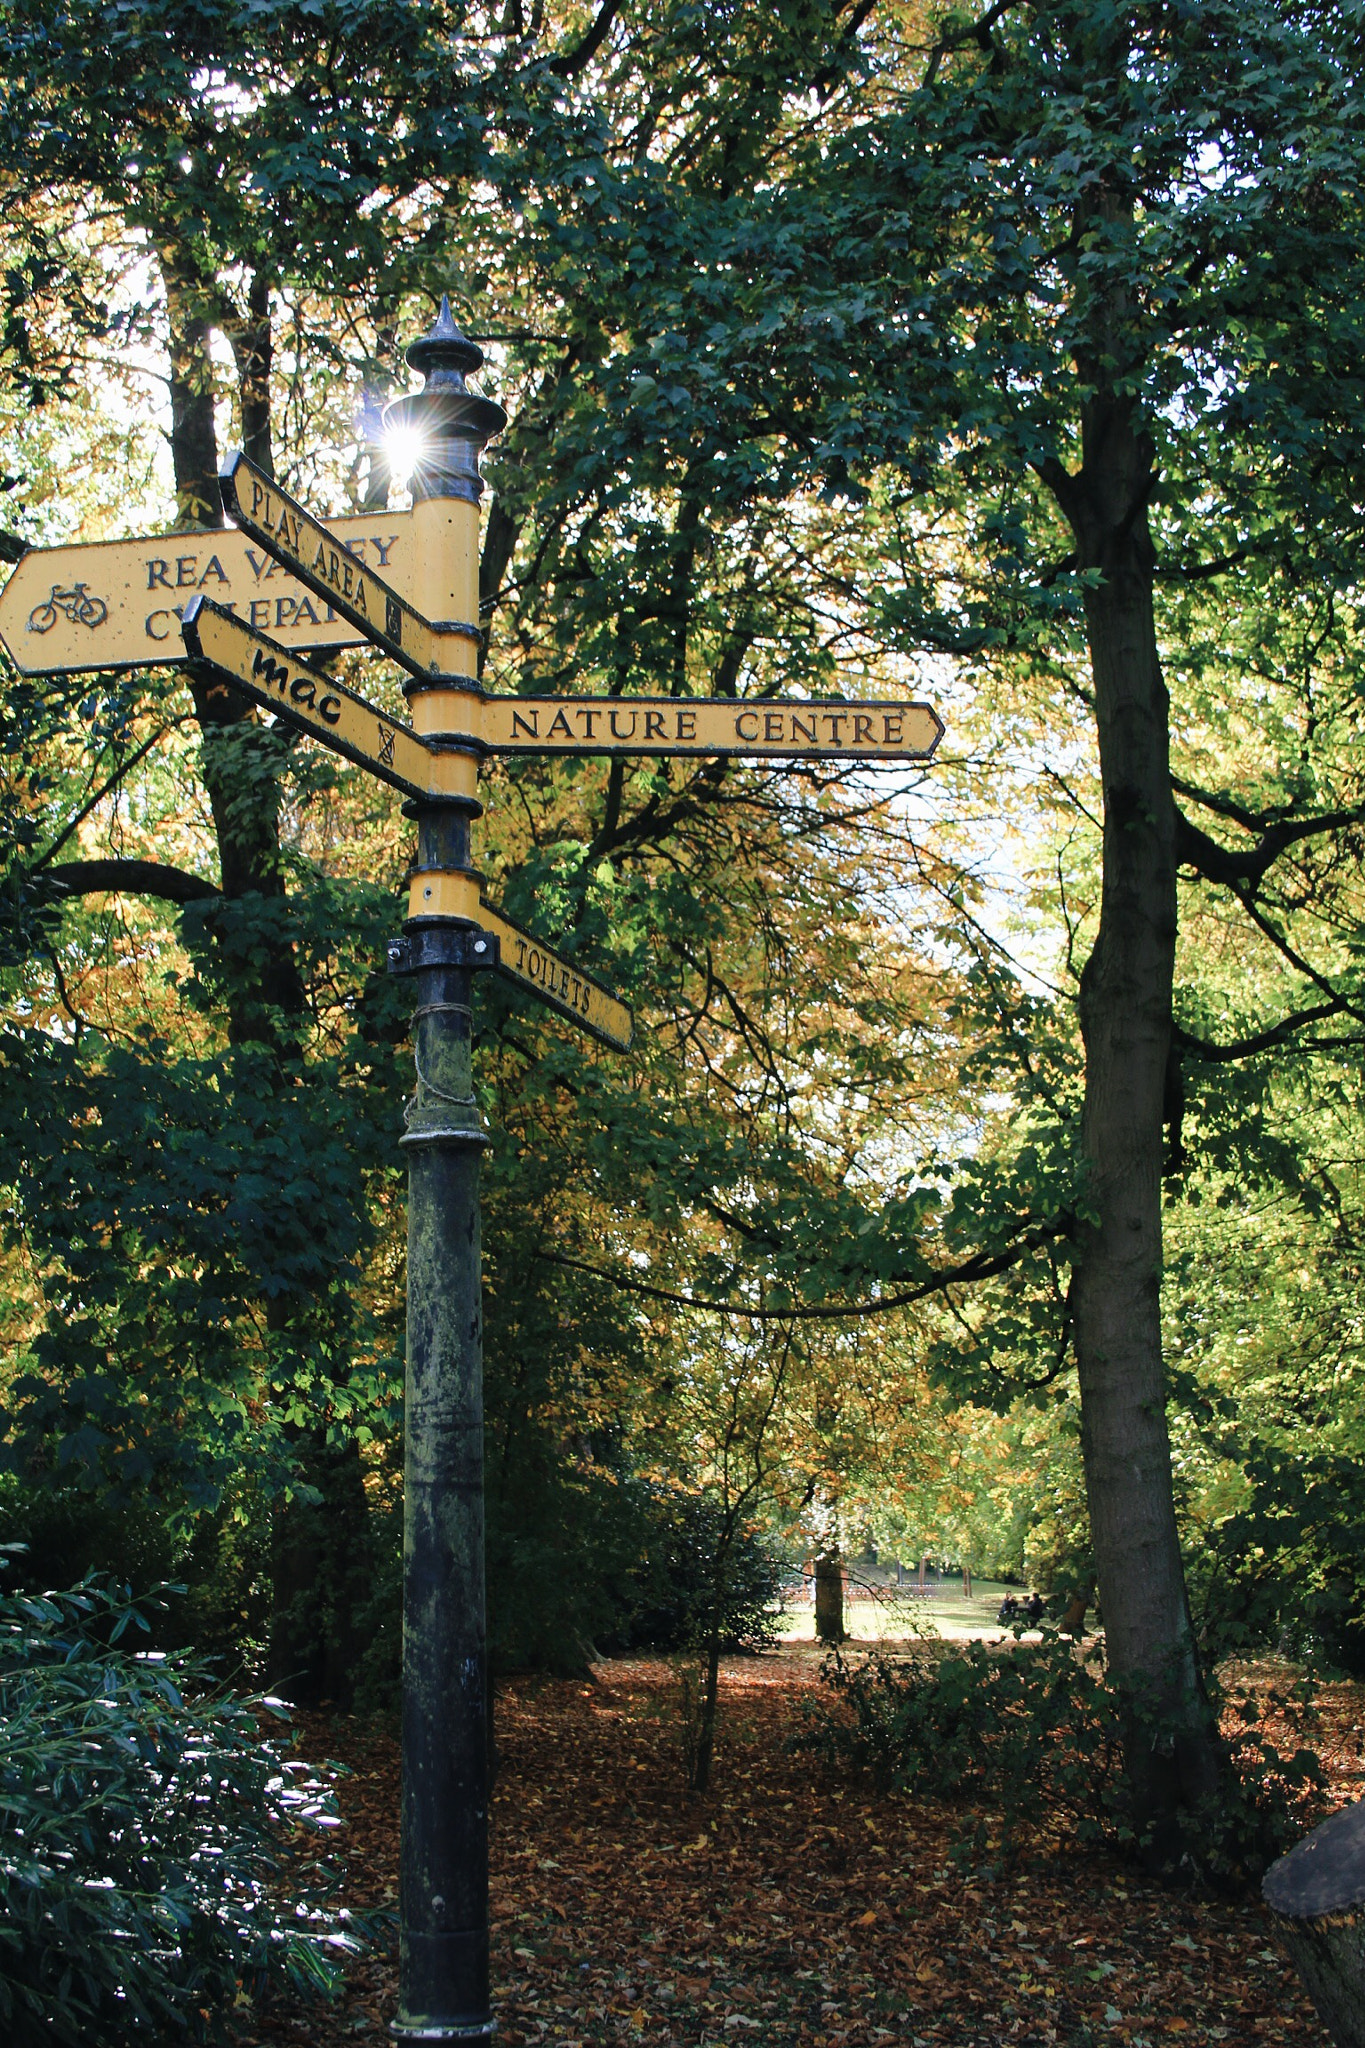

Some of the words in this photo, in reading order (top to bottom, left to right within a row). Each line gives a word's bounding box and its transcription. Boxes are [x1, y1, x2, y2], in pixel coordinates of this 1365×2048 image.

[146, 554, 229, 590] REA
[244, 534, 399, 580] VAEY
[251, 480, 303, 554] PLAY
[311, 541, 367, 612] AREA
[252, 648, 341, 724] mac
[510, 709, 697, 740] NATURE
[735, 712, 904, 743] CENTRE
[515, 938, 591, 1014] TOILETS
